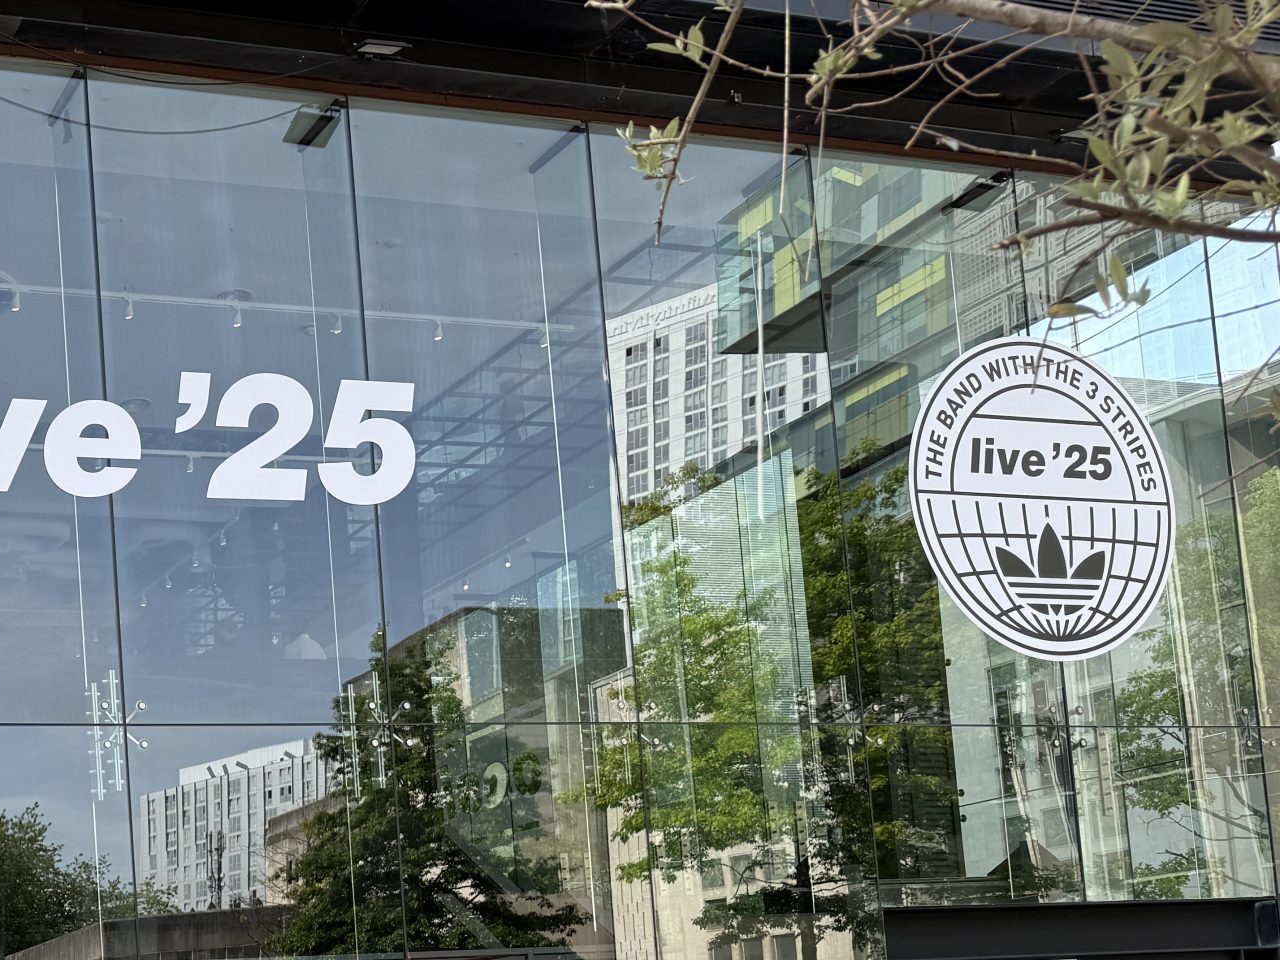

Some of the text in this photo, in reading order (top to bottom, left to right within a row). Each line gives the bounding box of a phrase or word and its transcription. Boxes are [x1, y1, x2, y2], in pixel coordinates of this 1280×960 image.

[175, 371, 415, 506] '25
[925, 355, 1158, 493] THE BAND WITH THE 3 STRIPES
[970, 437, 1113, 481] live '25
